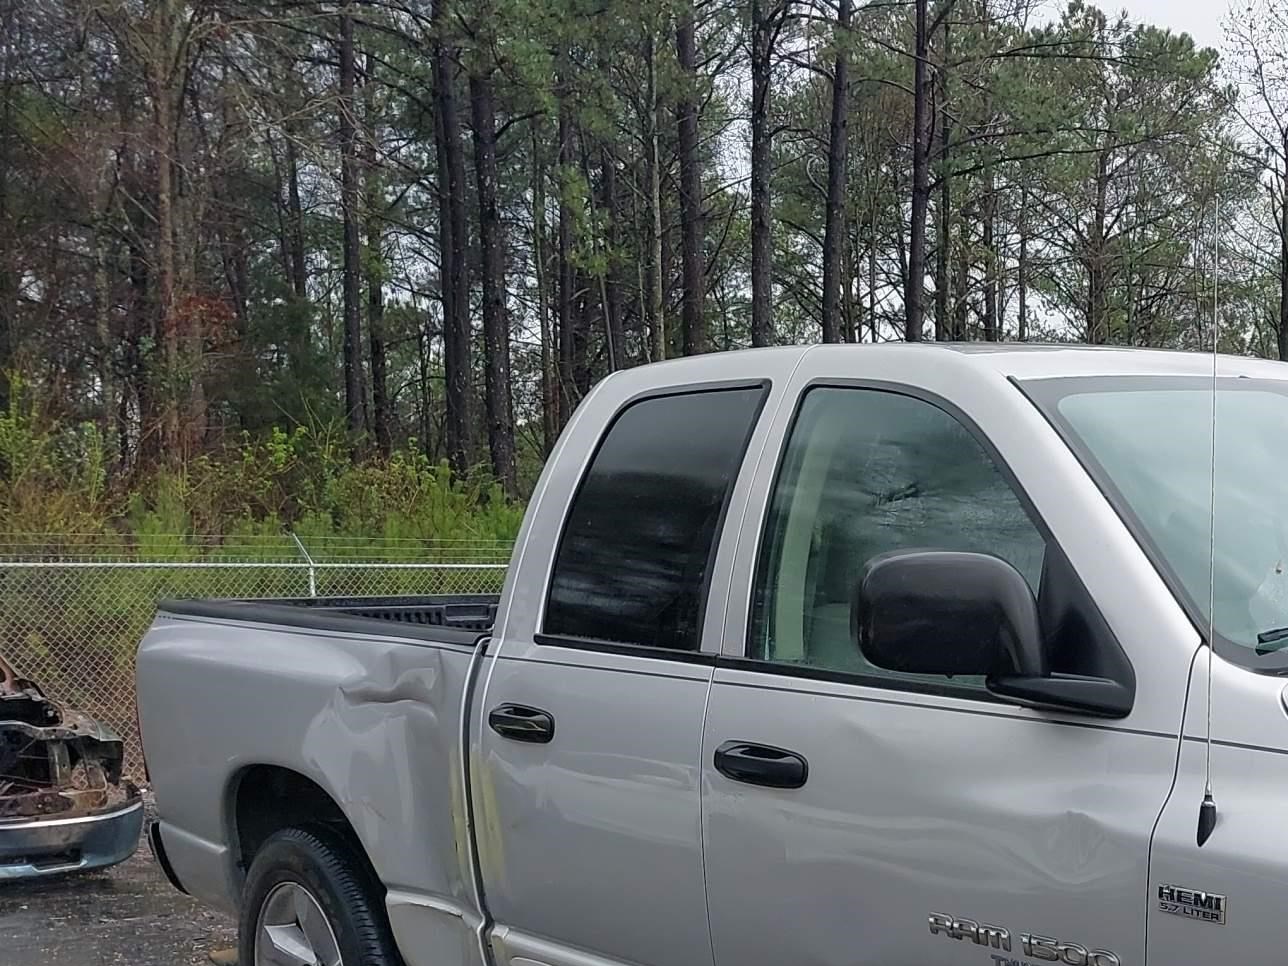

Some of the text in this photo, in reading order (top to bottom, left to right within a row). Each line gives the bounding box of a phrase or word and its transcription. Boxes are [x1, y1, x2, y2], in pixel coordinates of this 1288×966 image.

[1158, 885, 1224, 911] HEMI
[1159, 902, 1219, 920] 5.7 LITER
[927, 912, 1011, 951] RAM
